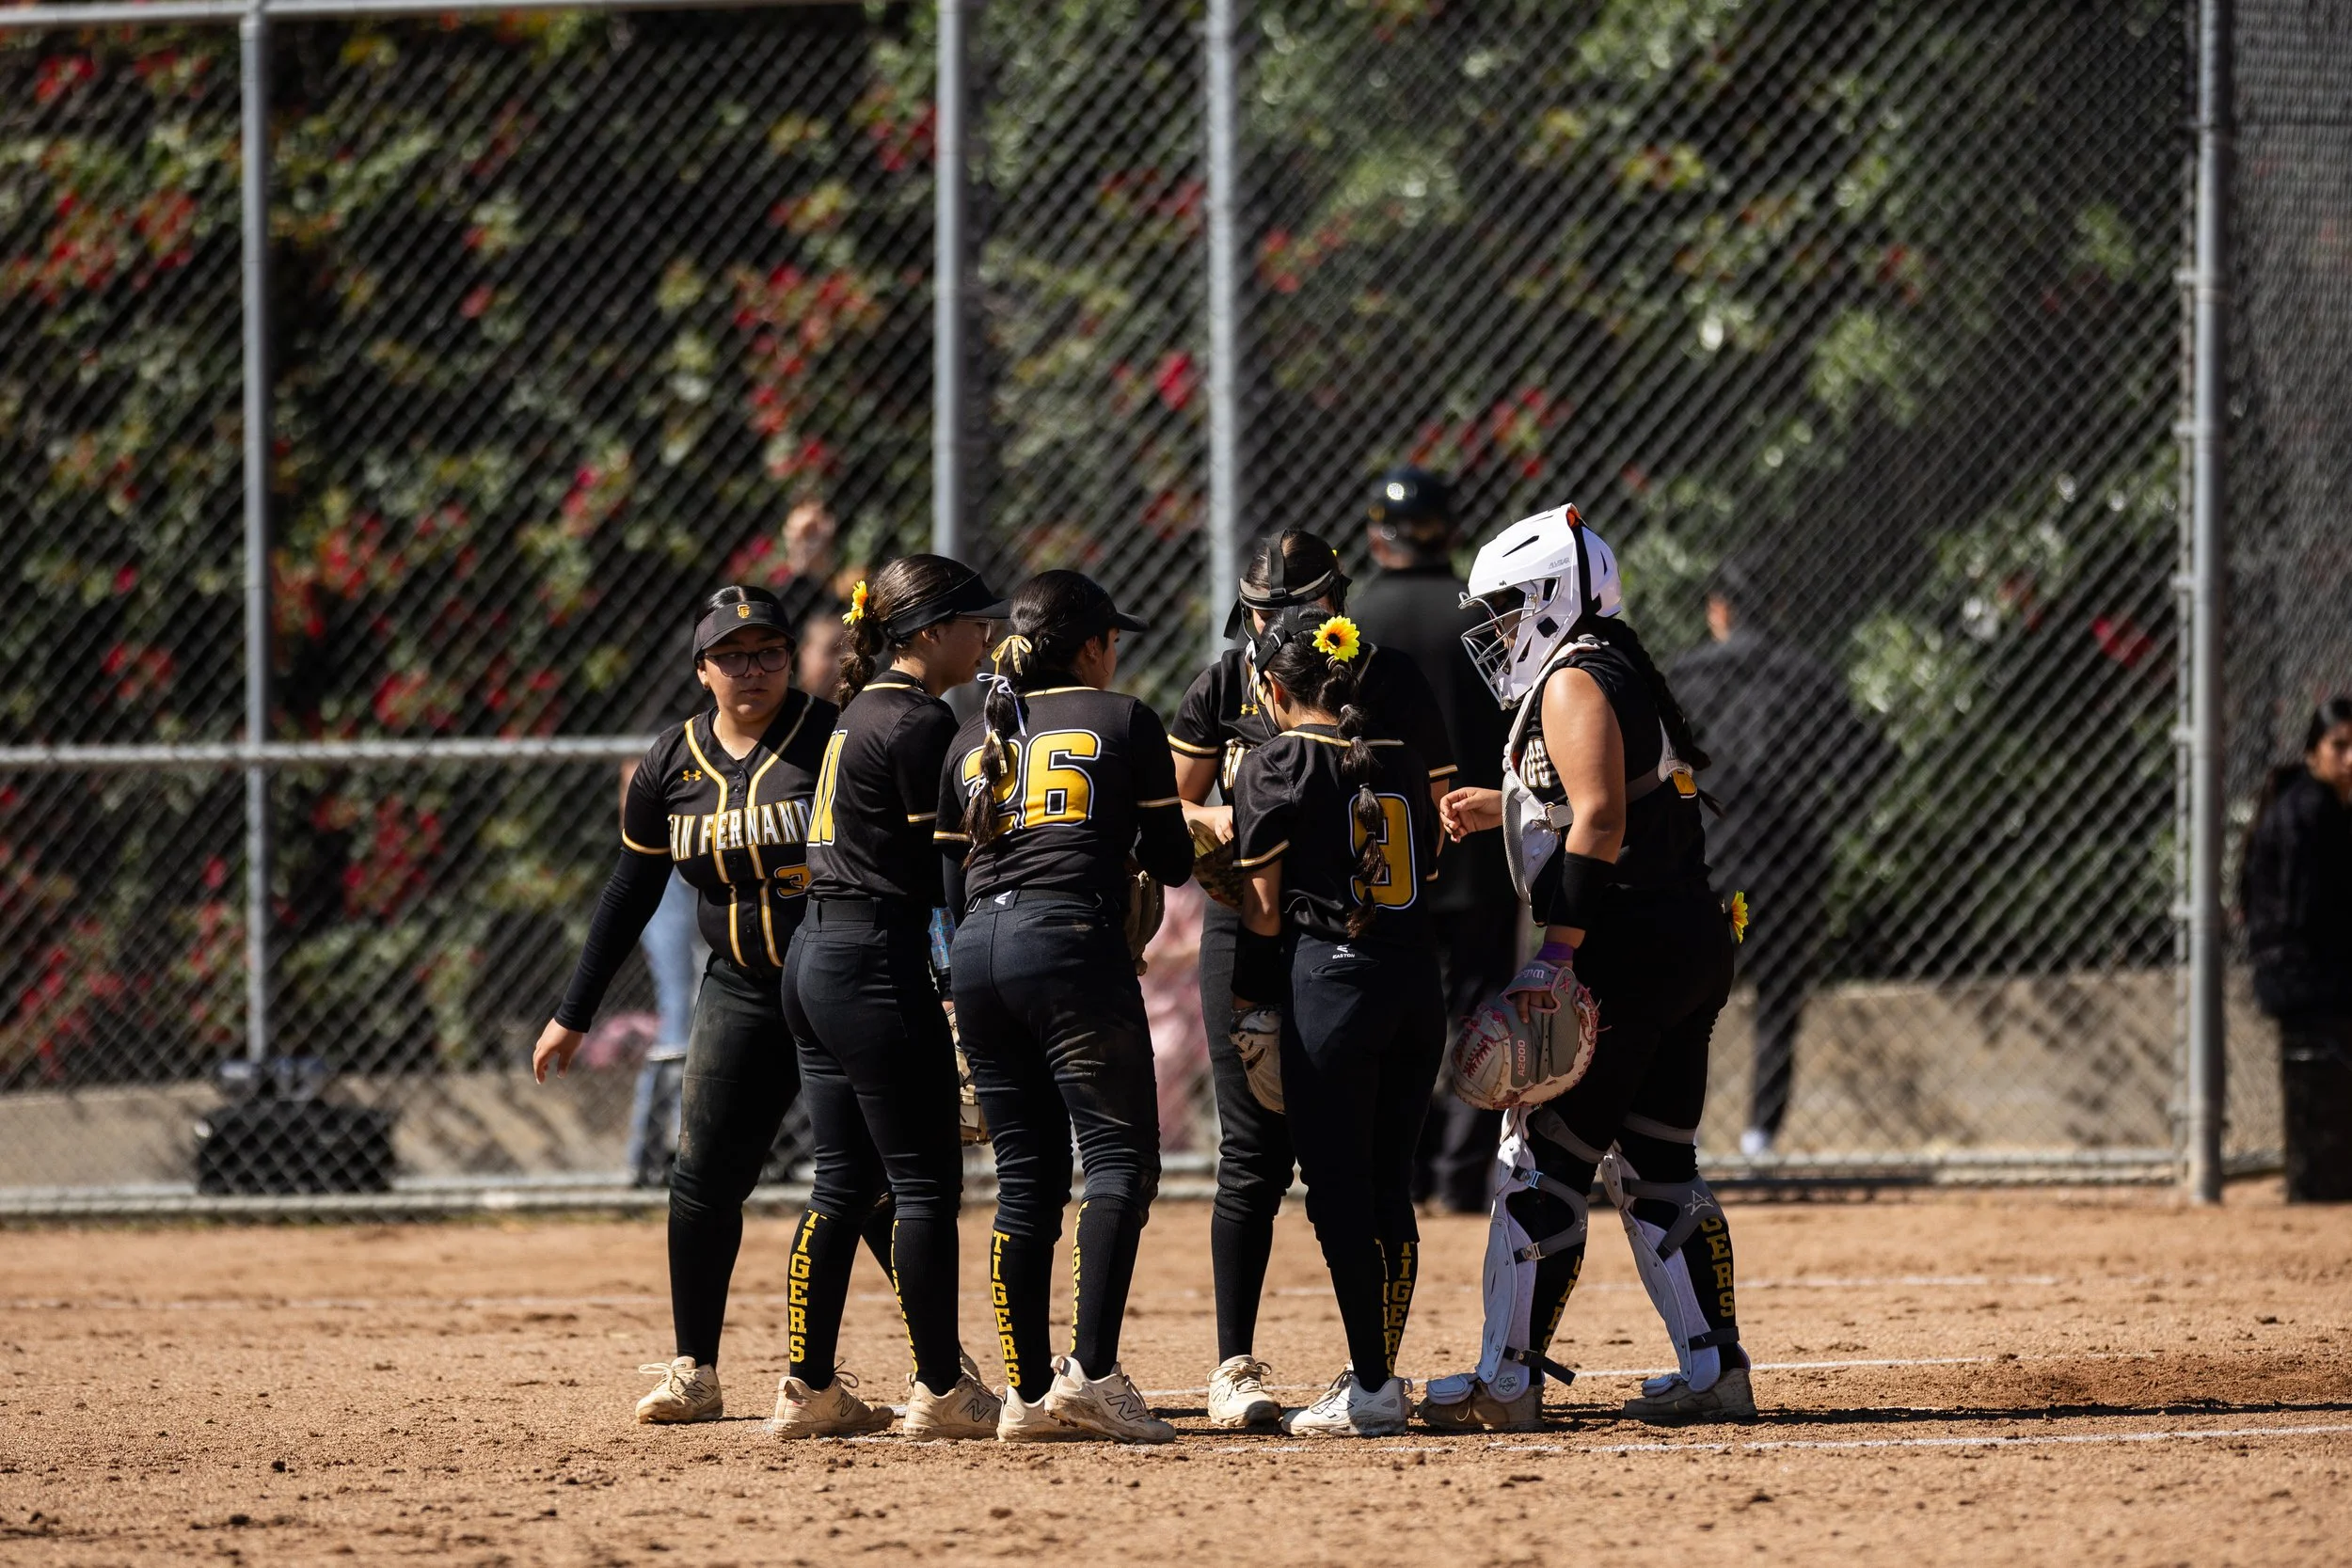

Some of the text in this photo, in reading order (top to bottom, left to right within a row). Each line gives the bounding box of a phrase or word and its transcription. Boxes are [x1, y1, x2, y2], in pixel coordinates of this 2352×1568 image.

[668, 814, 696, 862] AN
[961, 729, 1102, 836] 26
[1347, 792, 1417, 911] 9
[1518, 1039, 1526, 1077] A2000
[789, 1210, 828, 1363] TIGERS
[992, 1230, 1022, 1387] TIGERS
